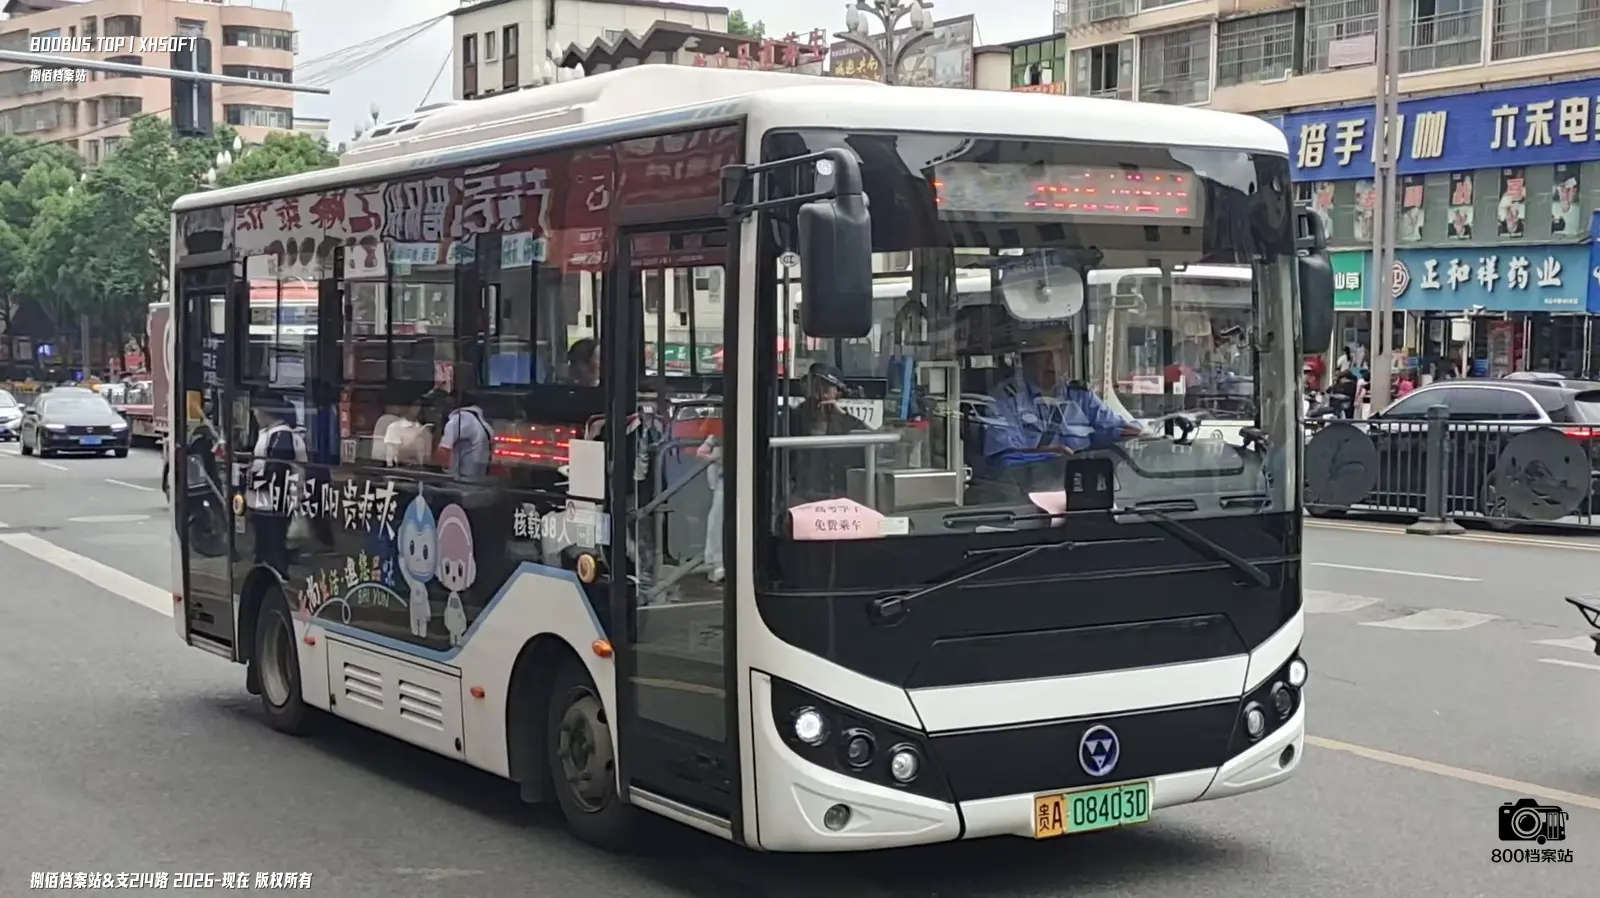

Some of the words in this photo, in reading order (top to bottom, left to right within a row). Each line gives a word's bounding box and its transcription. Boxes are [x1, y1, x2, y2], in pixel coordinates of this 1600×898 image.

[1490, 95, 1600, 149] 六禾电
[1420, 255, 1562, 293] 正和祥药业
[1073, 788, 1147, 826] 08403D
